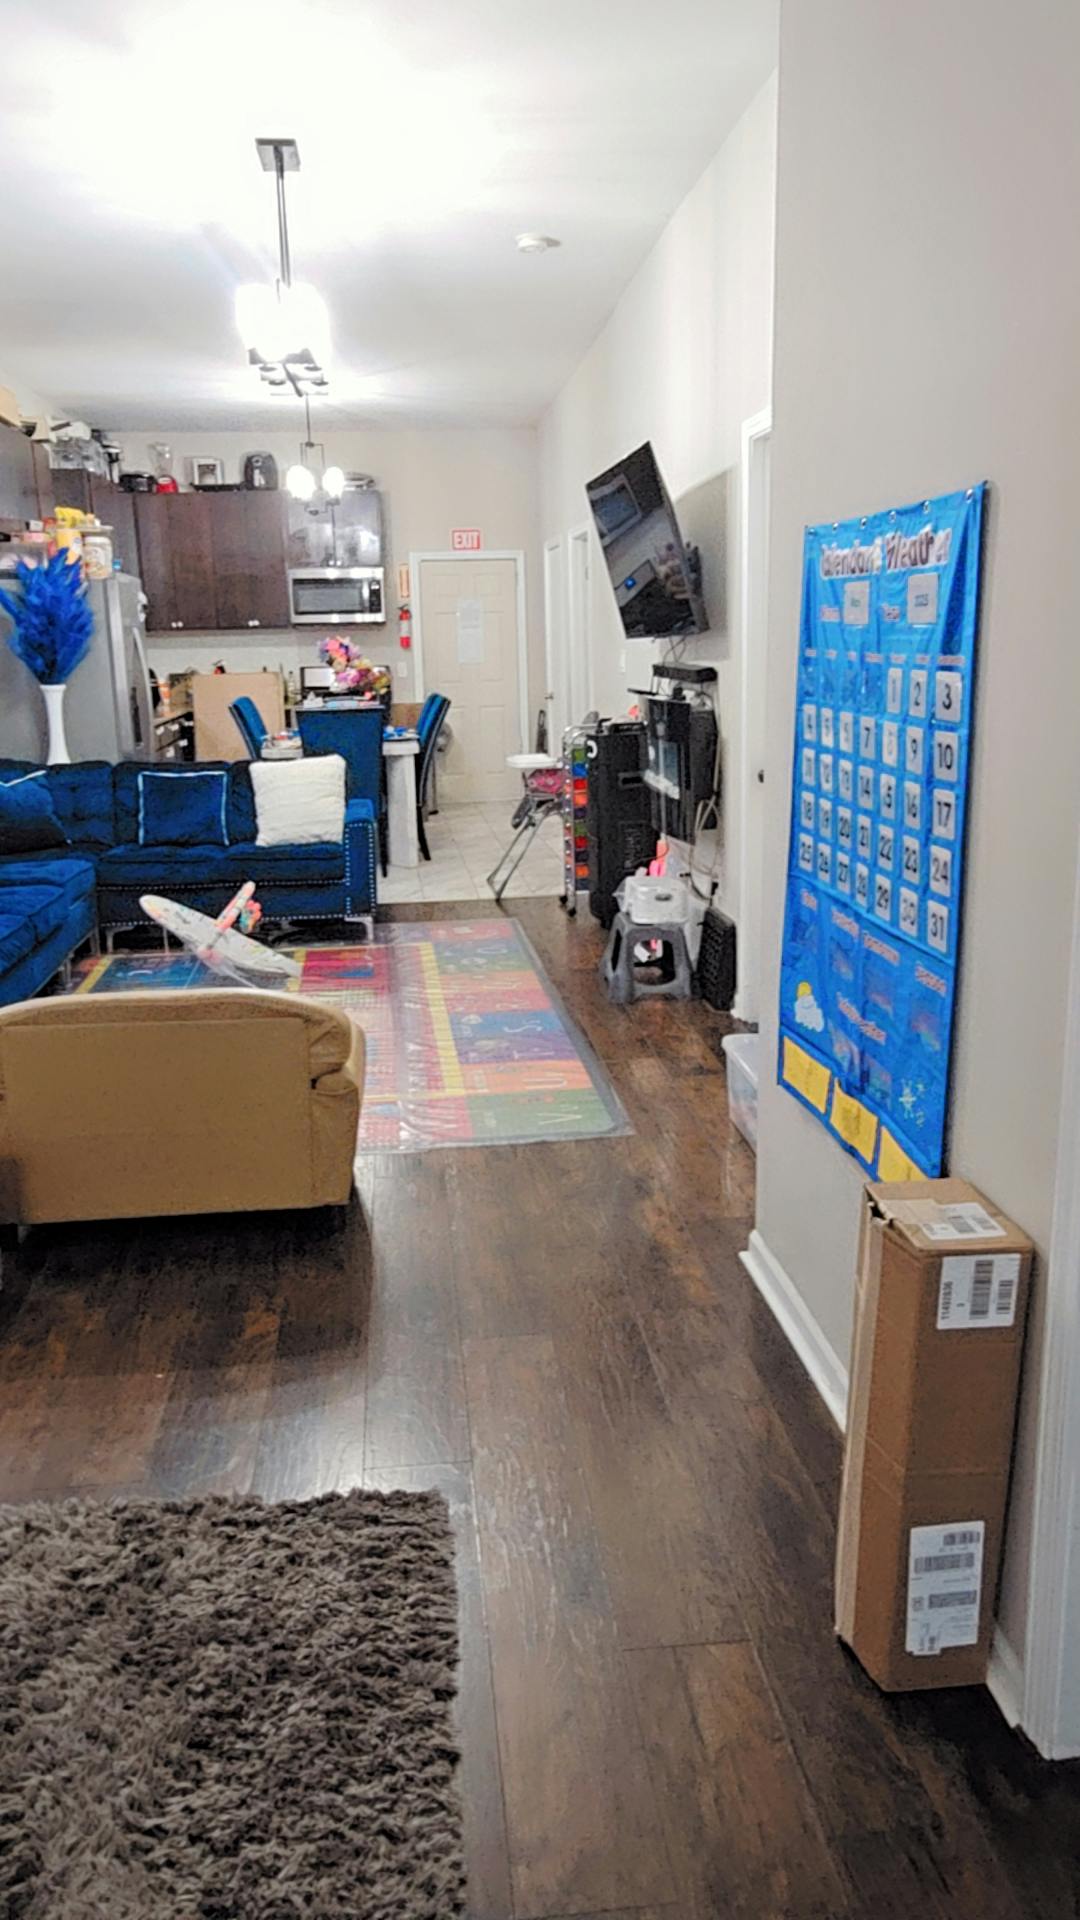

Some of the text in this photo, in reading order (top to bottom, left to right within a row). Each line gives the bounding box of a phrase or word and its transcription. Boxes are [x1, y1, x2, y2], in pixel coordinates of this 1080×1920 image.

[454, 531, 479, 549] EXIT
[913, 681, 921, 707] 2
[942, 683, 953, 710] 3
[864, 726, 871, 749] 7
[936, 742, 954, 770] 10
[936, 800, 952, 829] 17
[879, 835, 892, 862] 22
[905, 846, 917, 873] 23
[931, 857, 949, 886] 24
[876, 884, 889, 911] 29
[930, 913, 944, 941] 31
